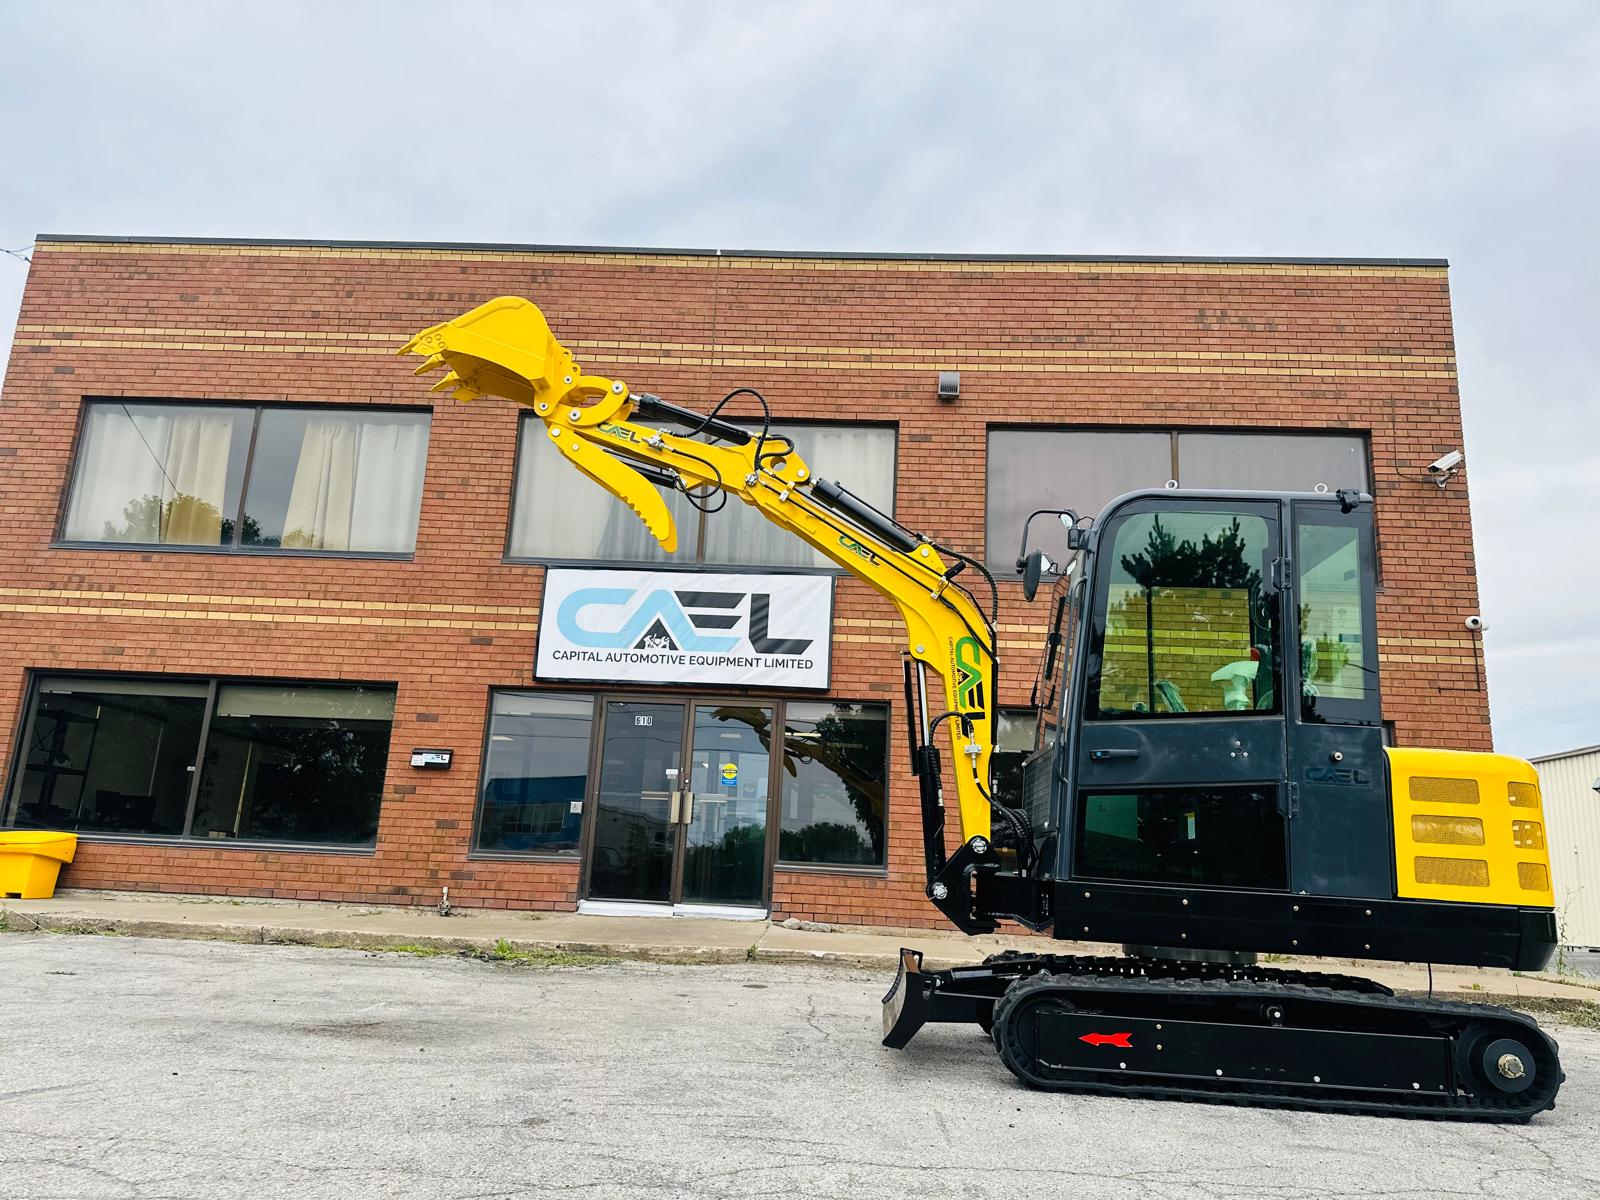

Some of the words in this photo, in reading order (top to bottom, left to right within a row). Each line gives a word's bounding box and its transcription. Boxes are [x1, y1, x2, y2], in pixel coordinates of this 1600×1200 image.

[596, 421, 640, 443] CAEL
[556, 587, 814, 655] CAEL
[552, 650, 602, 662] CAPITAL
[605, 653, 686, 665] AUTOMOTIVE
[689, 655, 761, 668] EQUIPMENT
[764, 658, 813, 670] LIMITED
[956, 636, 985, 739] CAEL
[635, 715, 653, 726] 610
[1305, 767, 1370, 785] CAEL
